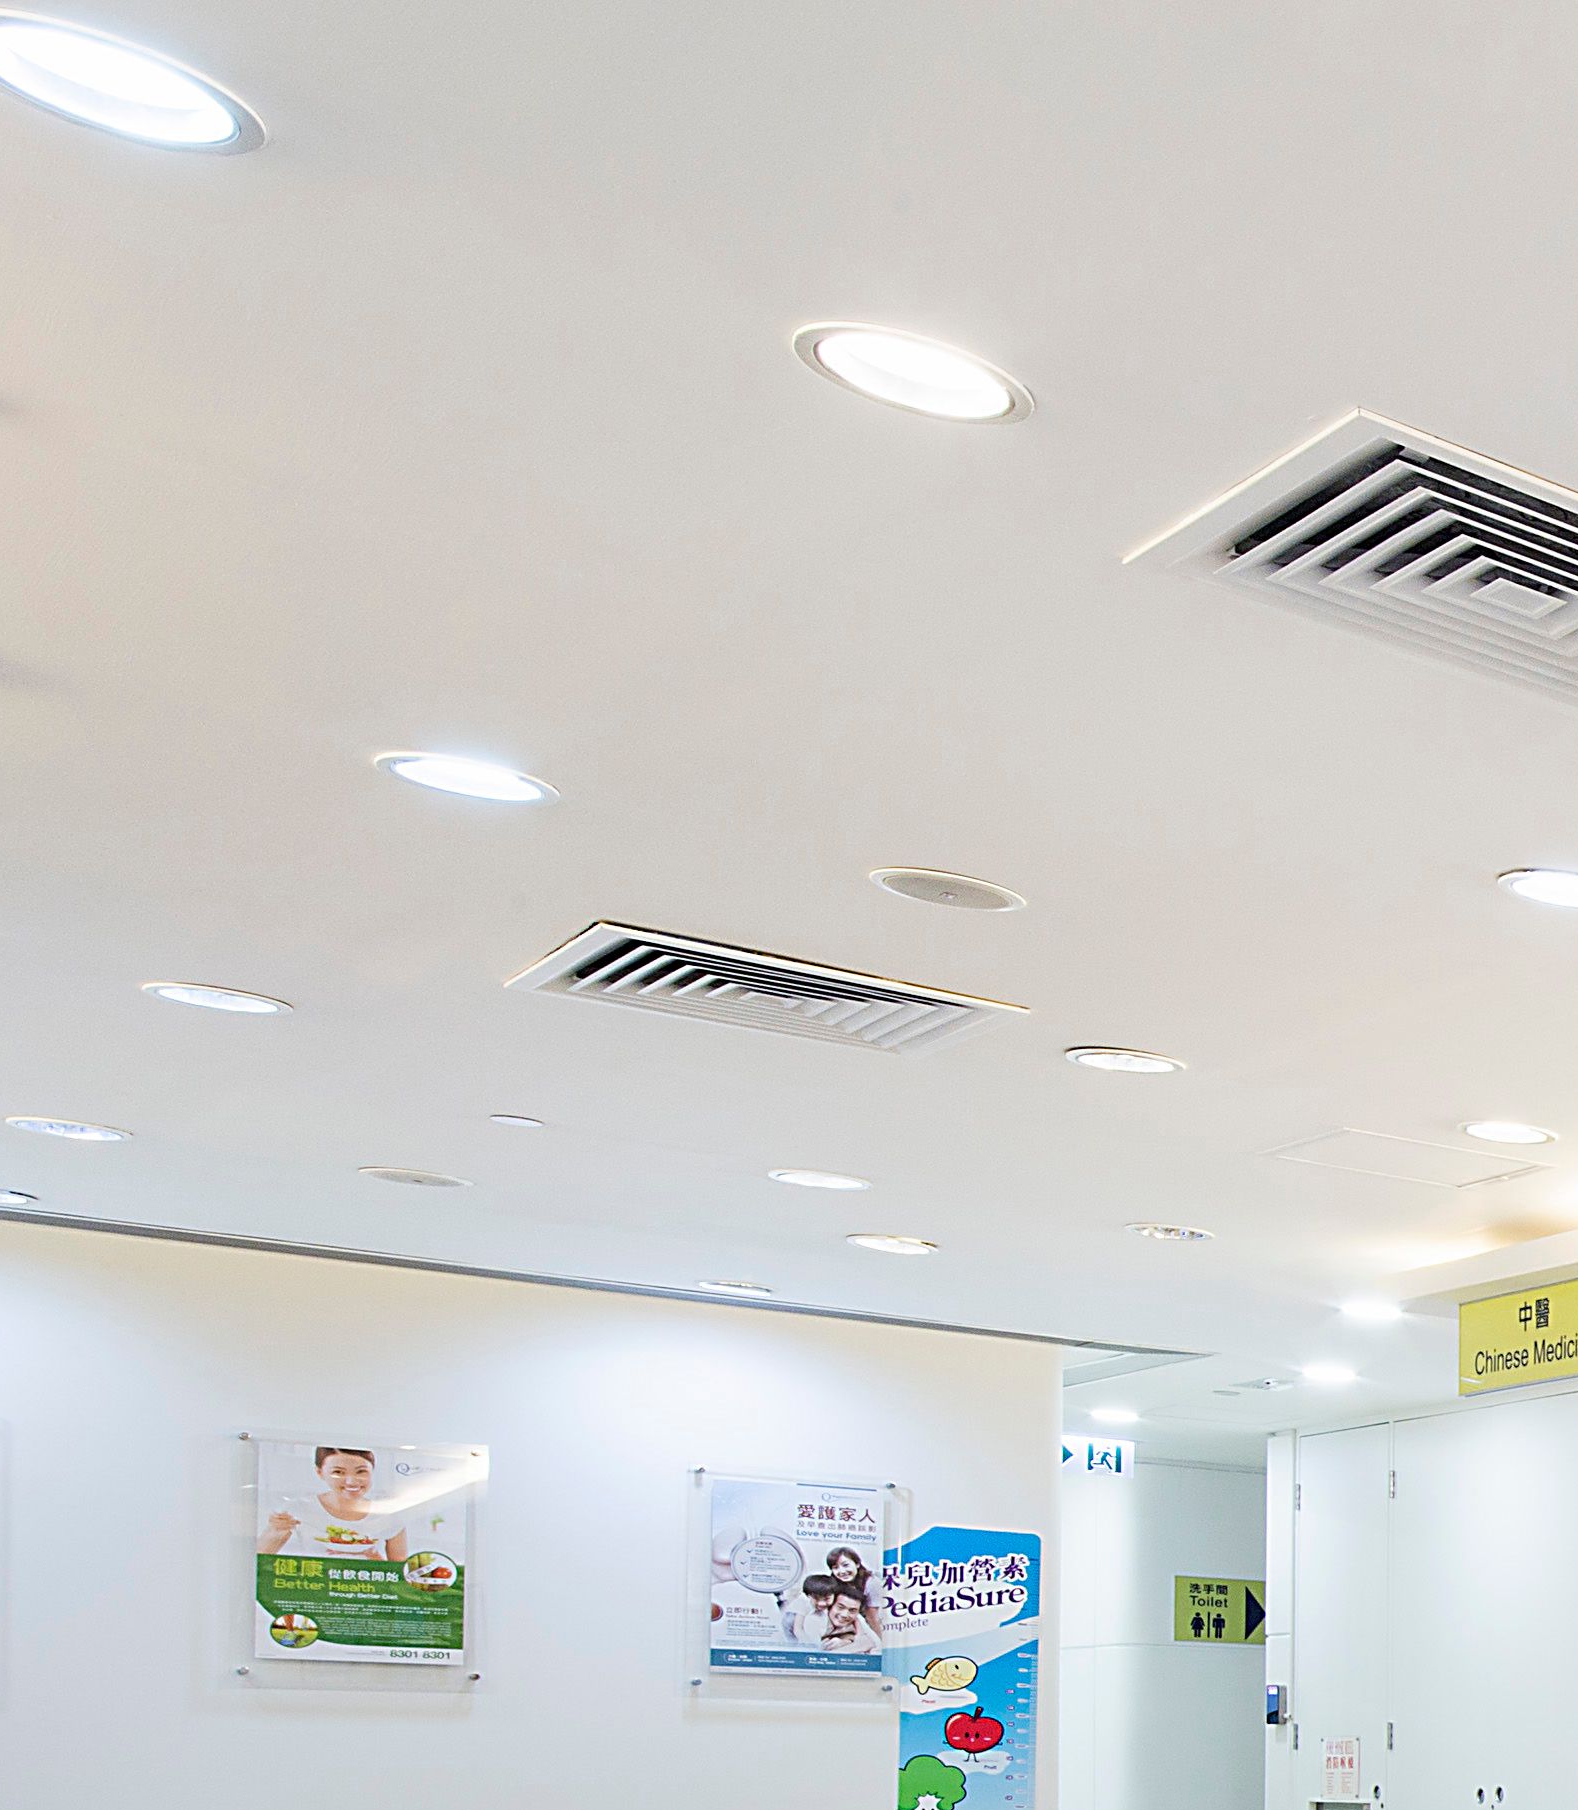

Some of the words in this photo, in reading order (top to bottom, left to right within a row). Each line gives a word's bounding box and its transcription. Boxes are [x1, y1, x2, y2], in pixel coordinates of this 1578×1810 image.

[1518, 1297, 1550, 1333] 中醫
[1474, 1347, 1529, 1377] Chinese
[796, 1503, 876, 1524] 愛護家人
[796, 1529, 820, 1538] Love
[822, 1531, 843, 1540] your
[845, 1532, 877, 1542] Family
[273, 1557, 325, 1578] 健康
[327, 1568, 400, 1583] 從飲食開始
[273, 1577, 325, 1591] Better
[328, 1581, 376, 1593] Health
[1188, 1583, 1229, 1597] 洗手間
[1189, 1595, 1229, 1609] Toilet
[882, 1617, 929, 1633] omplete
